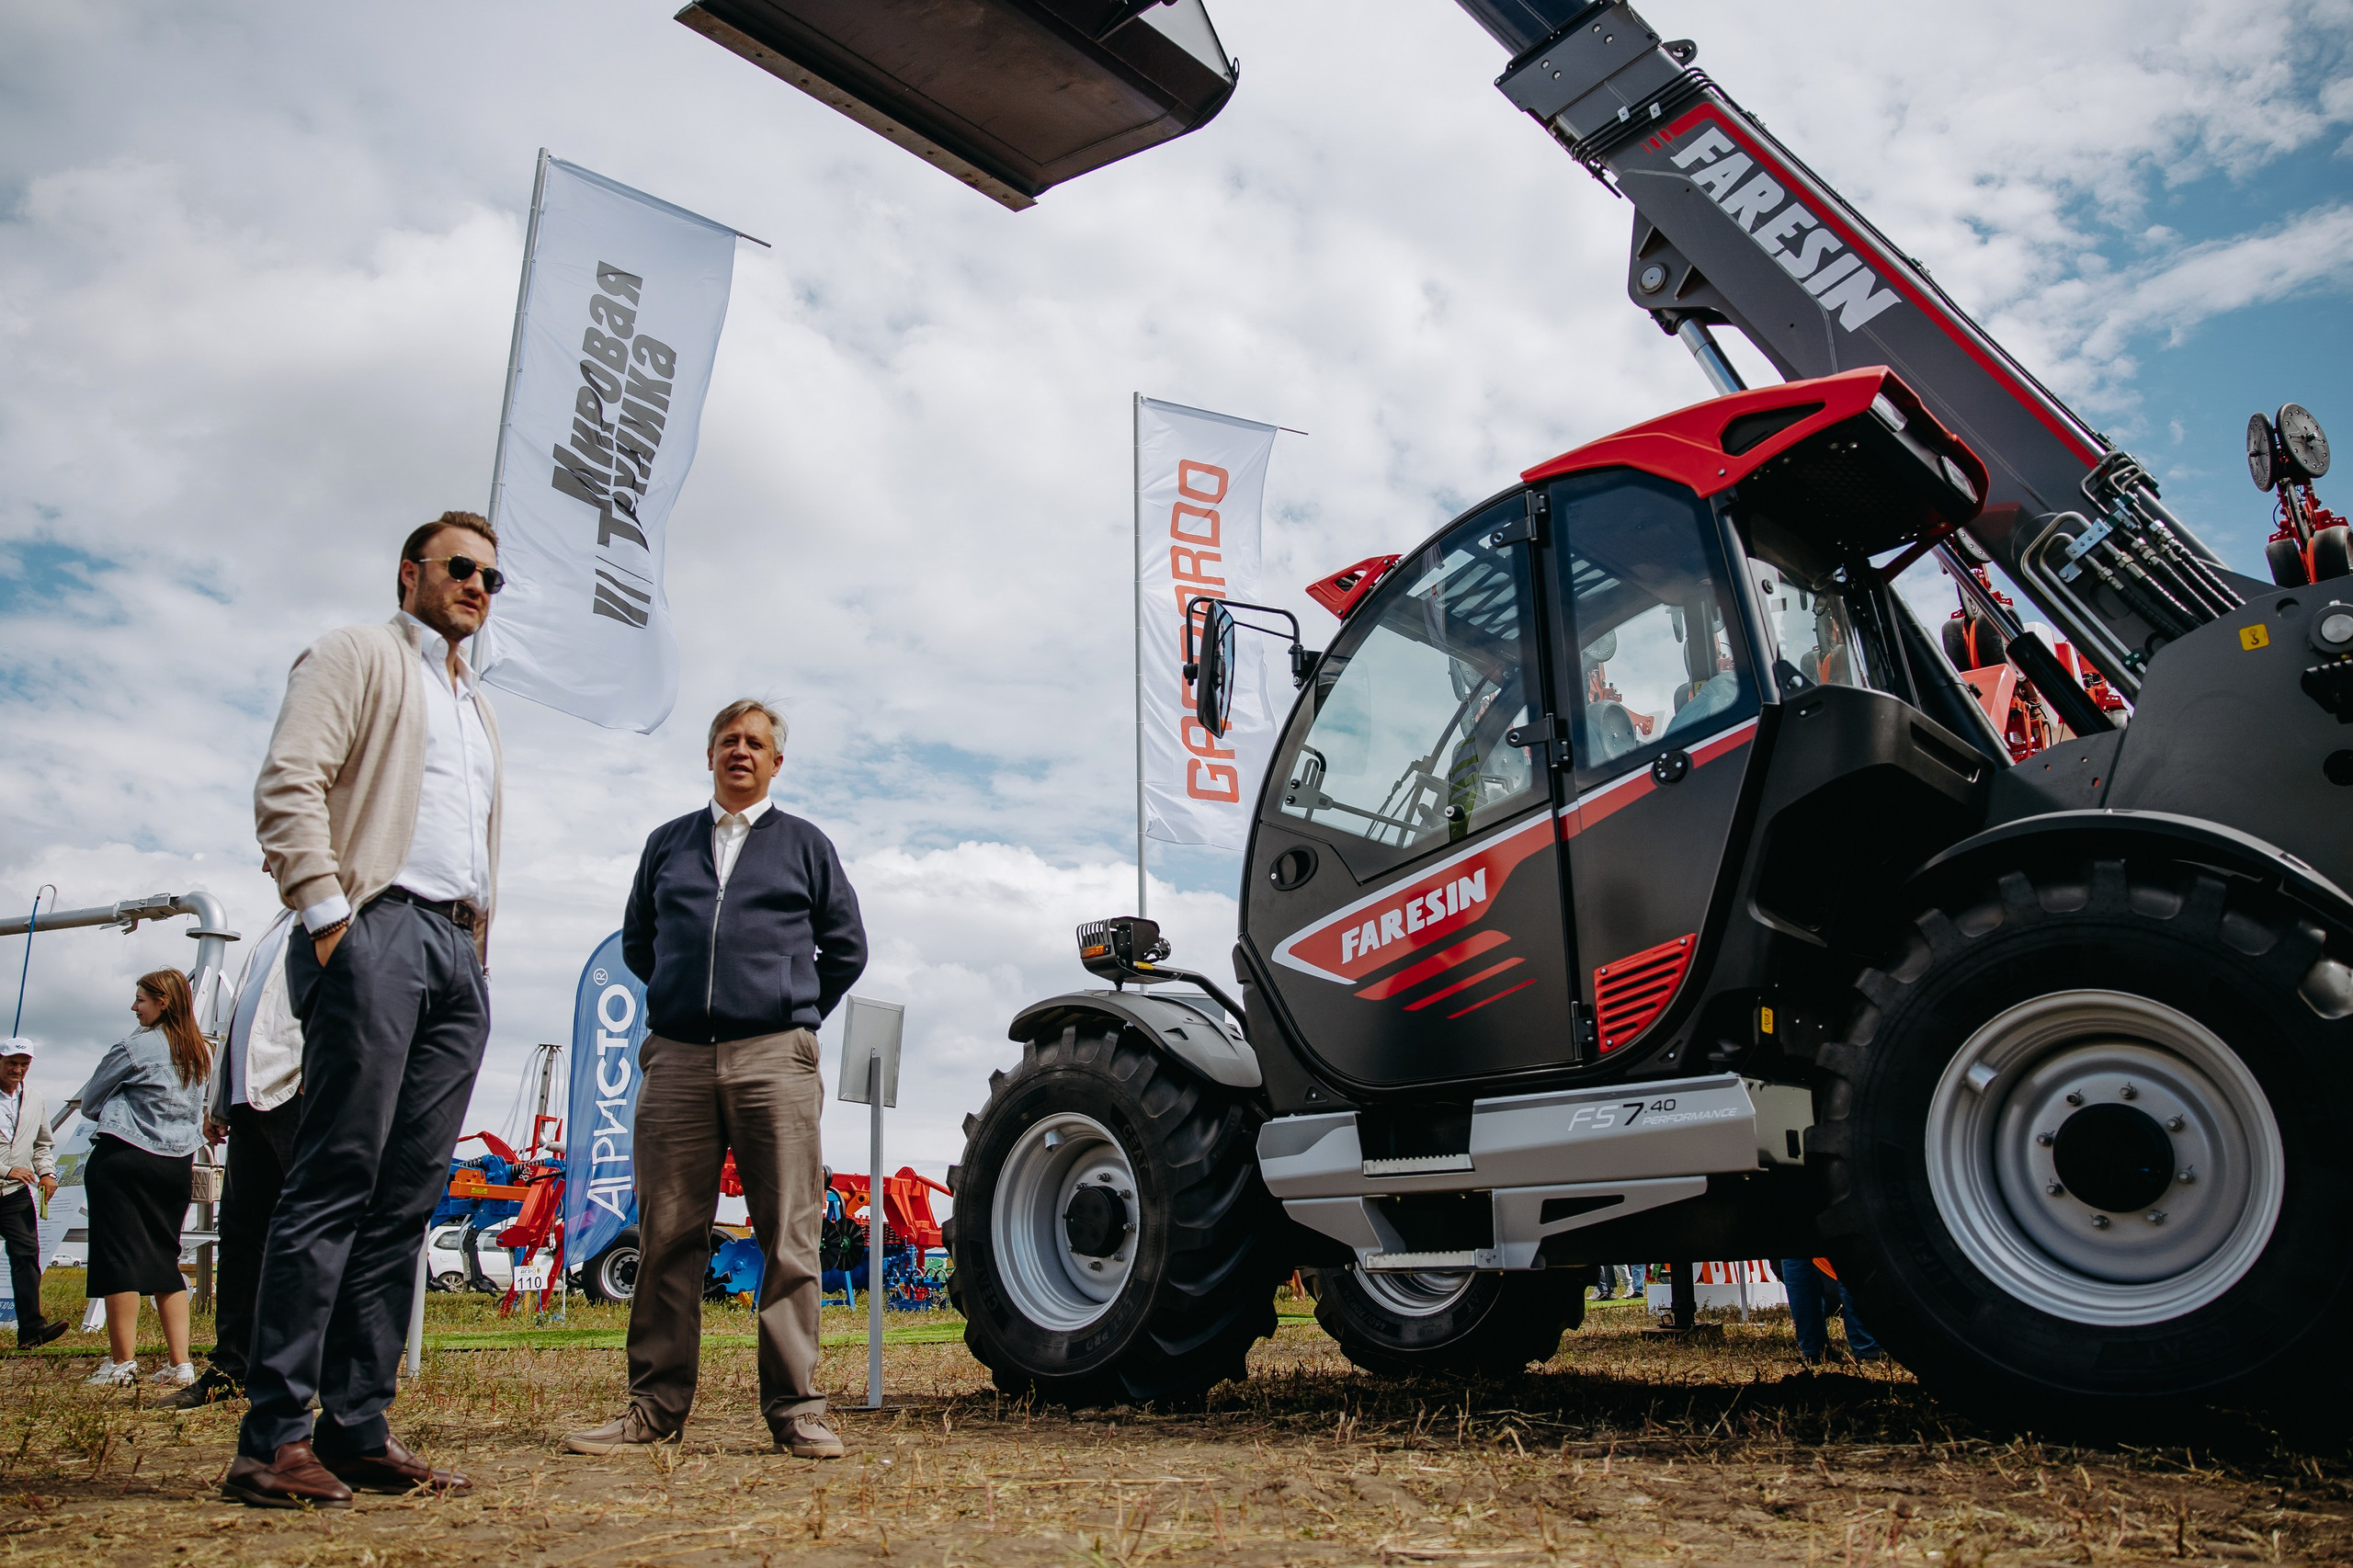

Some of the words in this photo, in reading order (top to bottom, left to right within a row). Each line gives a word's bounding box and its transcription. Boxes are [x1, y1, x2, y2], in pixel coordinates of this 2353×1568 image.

[1670, 127, 1902, 332] FARESIN
[1342, 868, 1487, 964] FARESIN
[1567, 1105, 1620, 1131] FS
[1642, 1108, 1739, 1126] PERFORMANCE
[1122, 1123, 1149, 1169] CEAT
[517, 1276, 542, 1290] 110
